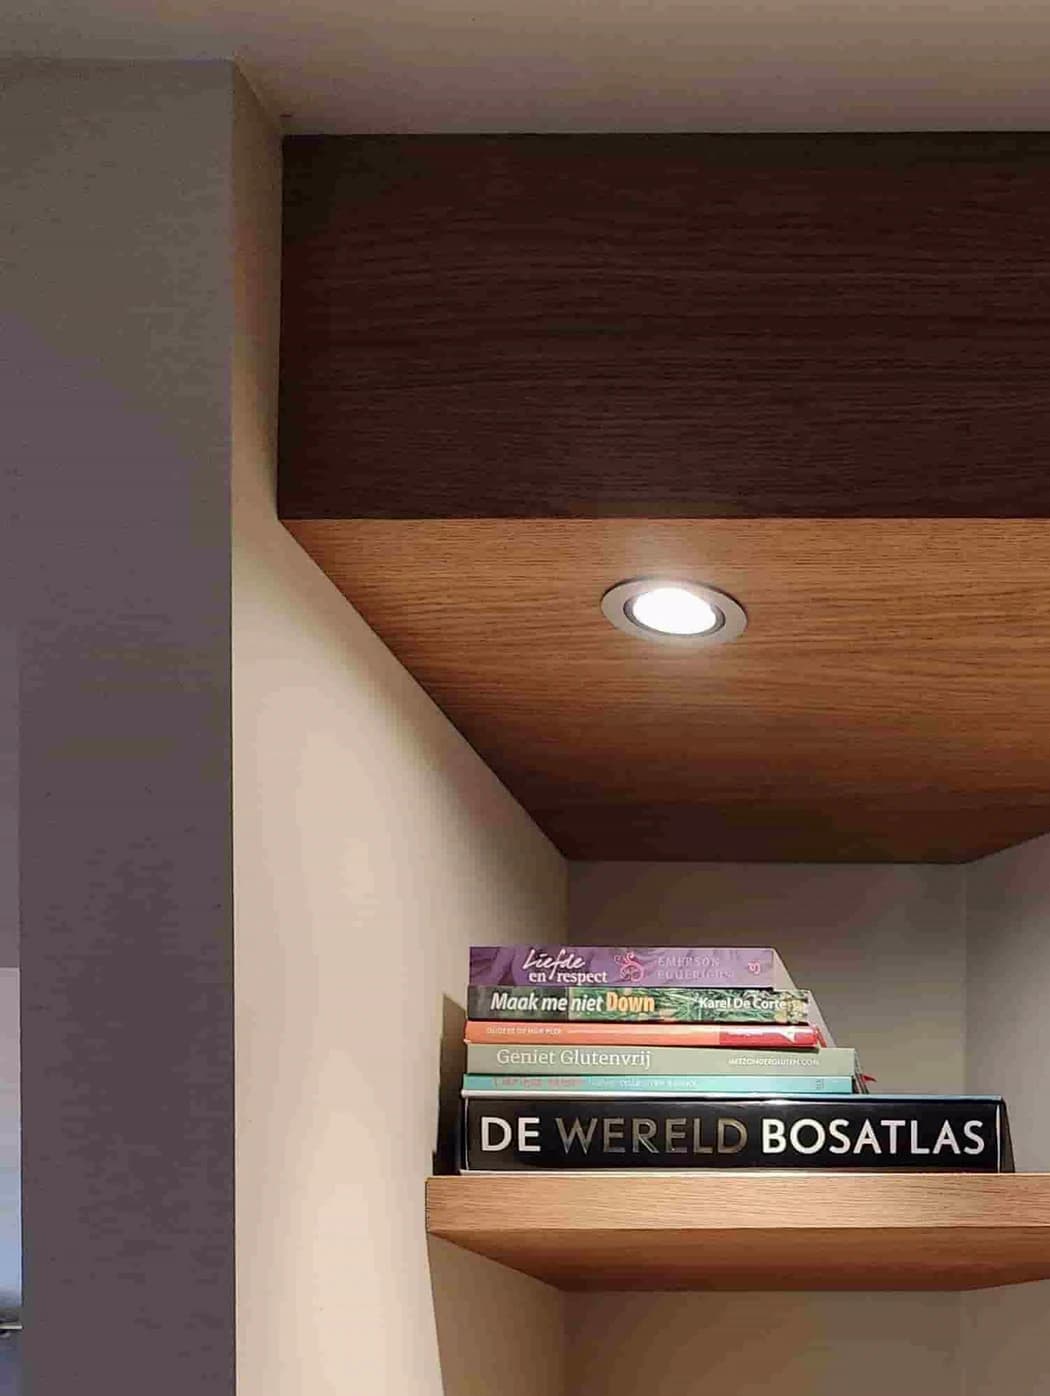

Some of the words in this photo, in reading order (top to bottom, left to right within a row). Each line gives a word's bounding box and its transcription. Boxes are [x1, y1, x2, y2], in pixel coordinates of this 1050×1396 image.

[522, 949, 587, 980] Liefde
[529, 972, 547, 983] en
[556, 970, 608, 986] respect
[490, 992, 537, 1011] Maak
[540, 997, 567, 1011] me
[570, 993, 604, 1012] niet
[606, 991, 655, 1013] Down
[700, 997, 732, 1009] Karel
[733, 997, 750, 1009] De
[496, 1050, 555, 1066] Geniet
[560, 1050, 652, 1070] Glutenvrij
[480, 1116, 541, 1153] DE
[555, 1116, 748, 1155] WERELD
[761, 1118, 986, 1156] BOSATLAS
